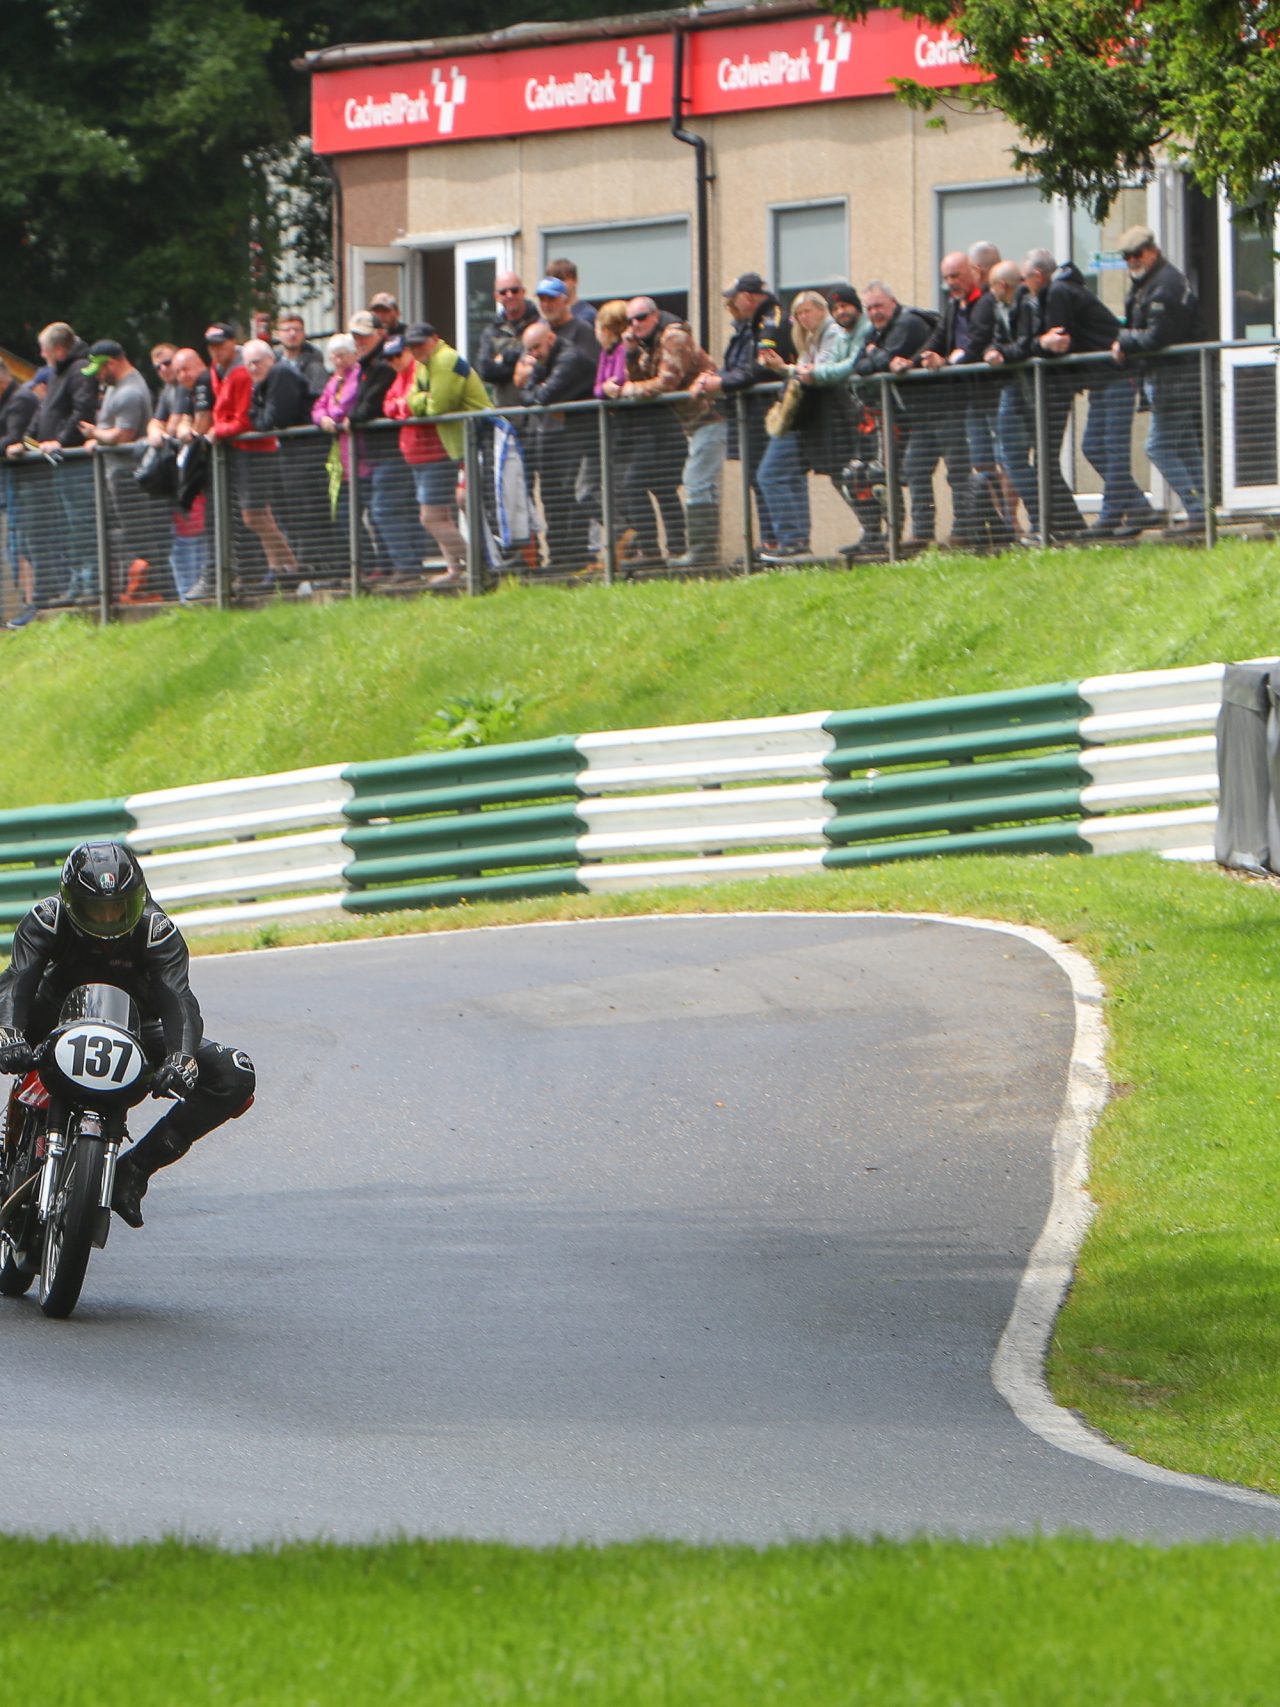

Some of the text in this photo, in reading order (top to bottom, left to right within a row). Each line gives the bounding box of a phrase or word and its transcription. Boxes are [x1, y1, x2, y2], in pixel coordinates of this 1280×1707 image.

[524, 69, 616, 112] CadwellPark
[717, 47, 810, 91] CadwellPark
[344, 89, 429, 131] CadwellPark
[67, 1034, 134, 1084] 137
